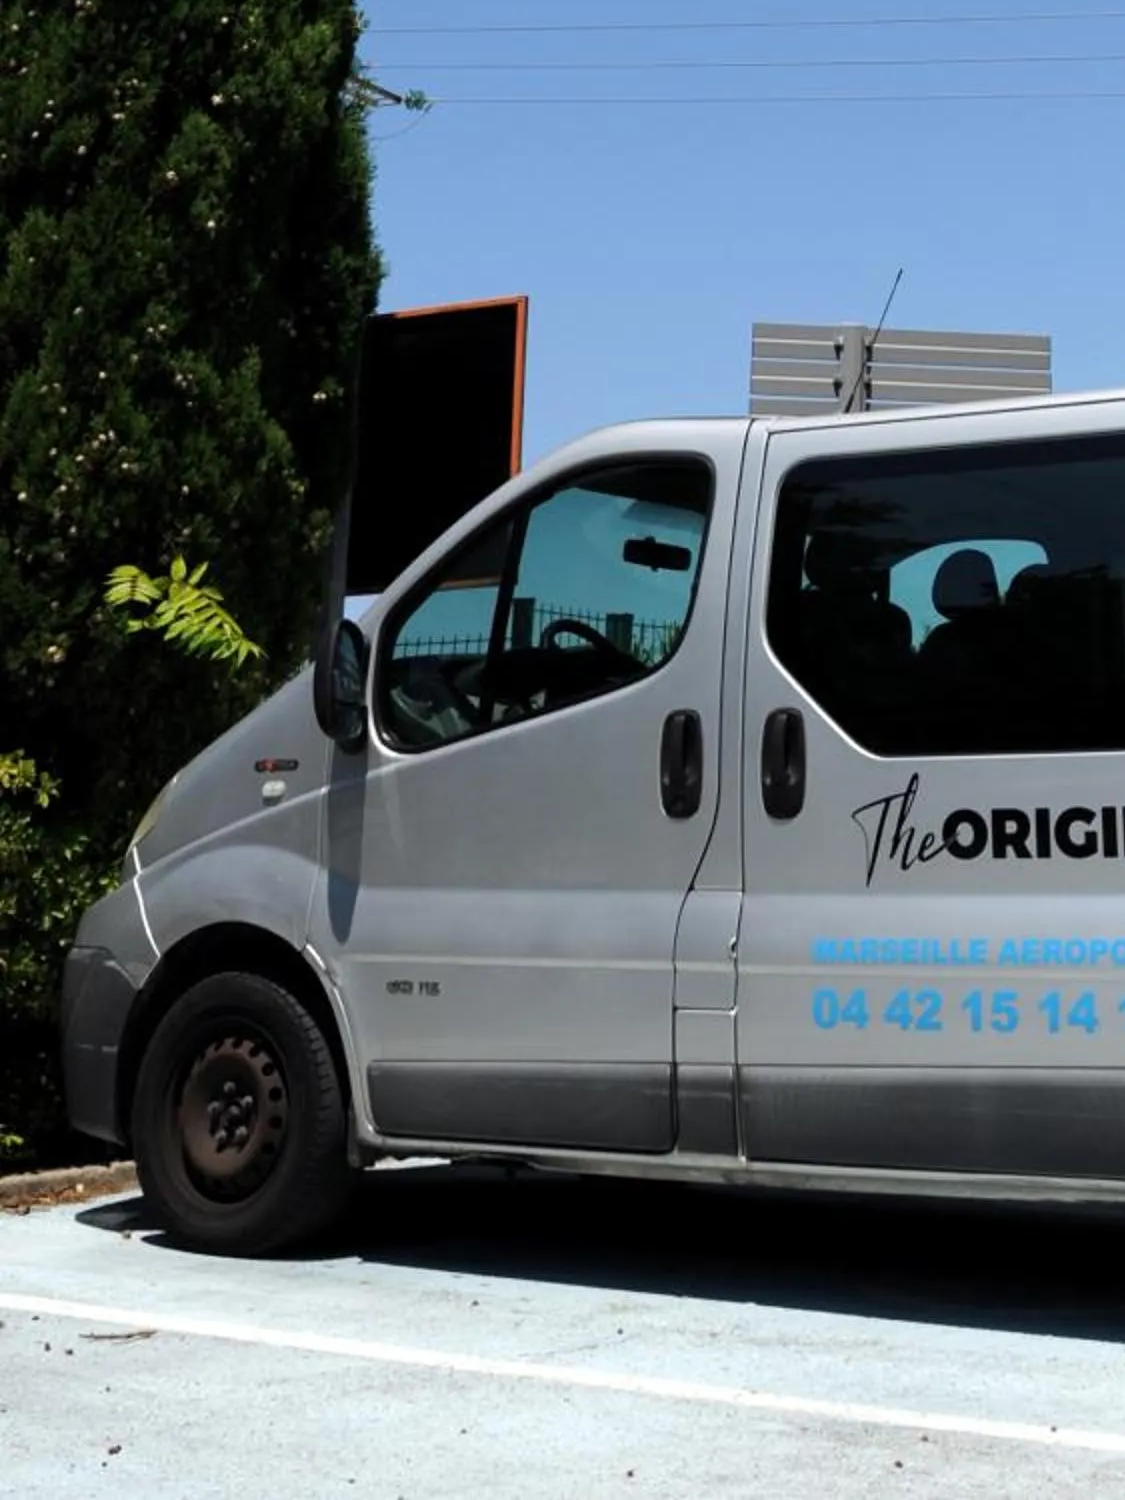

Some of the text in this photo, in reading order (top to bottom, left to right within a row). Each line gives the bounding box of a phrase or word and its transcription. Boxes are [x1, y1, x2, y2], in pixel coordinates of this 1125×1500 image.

[852, 772, 952, 887] The
[812, 937, 988, 964] MARSEILLE
[812, 988, 869, 1029] 04
[884, 988, 944, 1031] 42
[963, 989, 1020, 1032] 15
[1039, 990, 1098, 1033] 14
